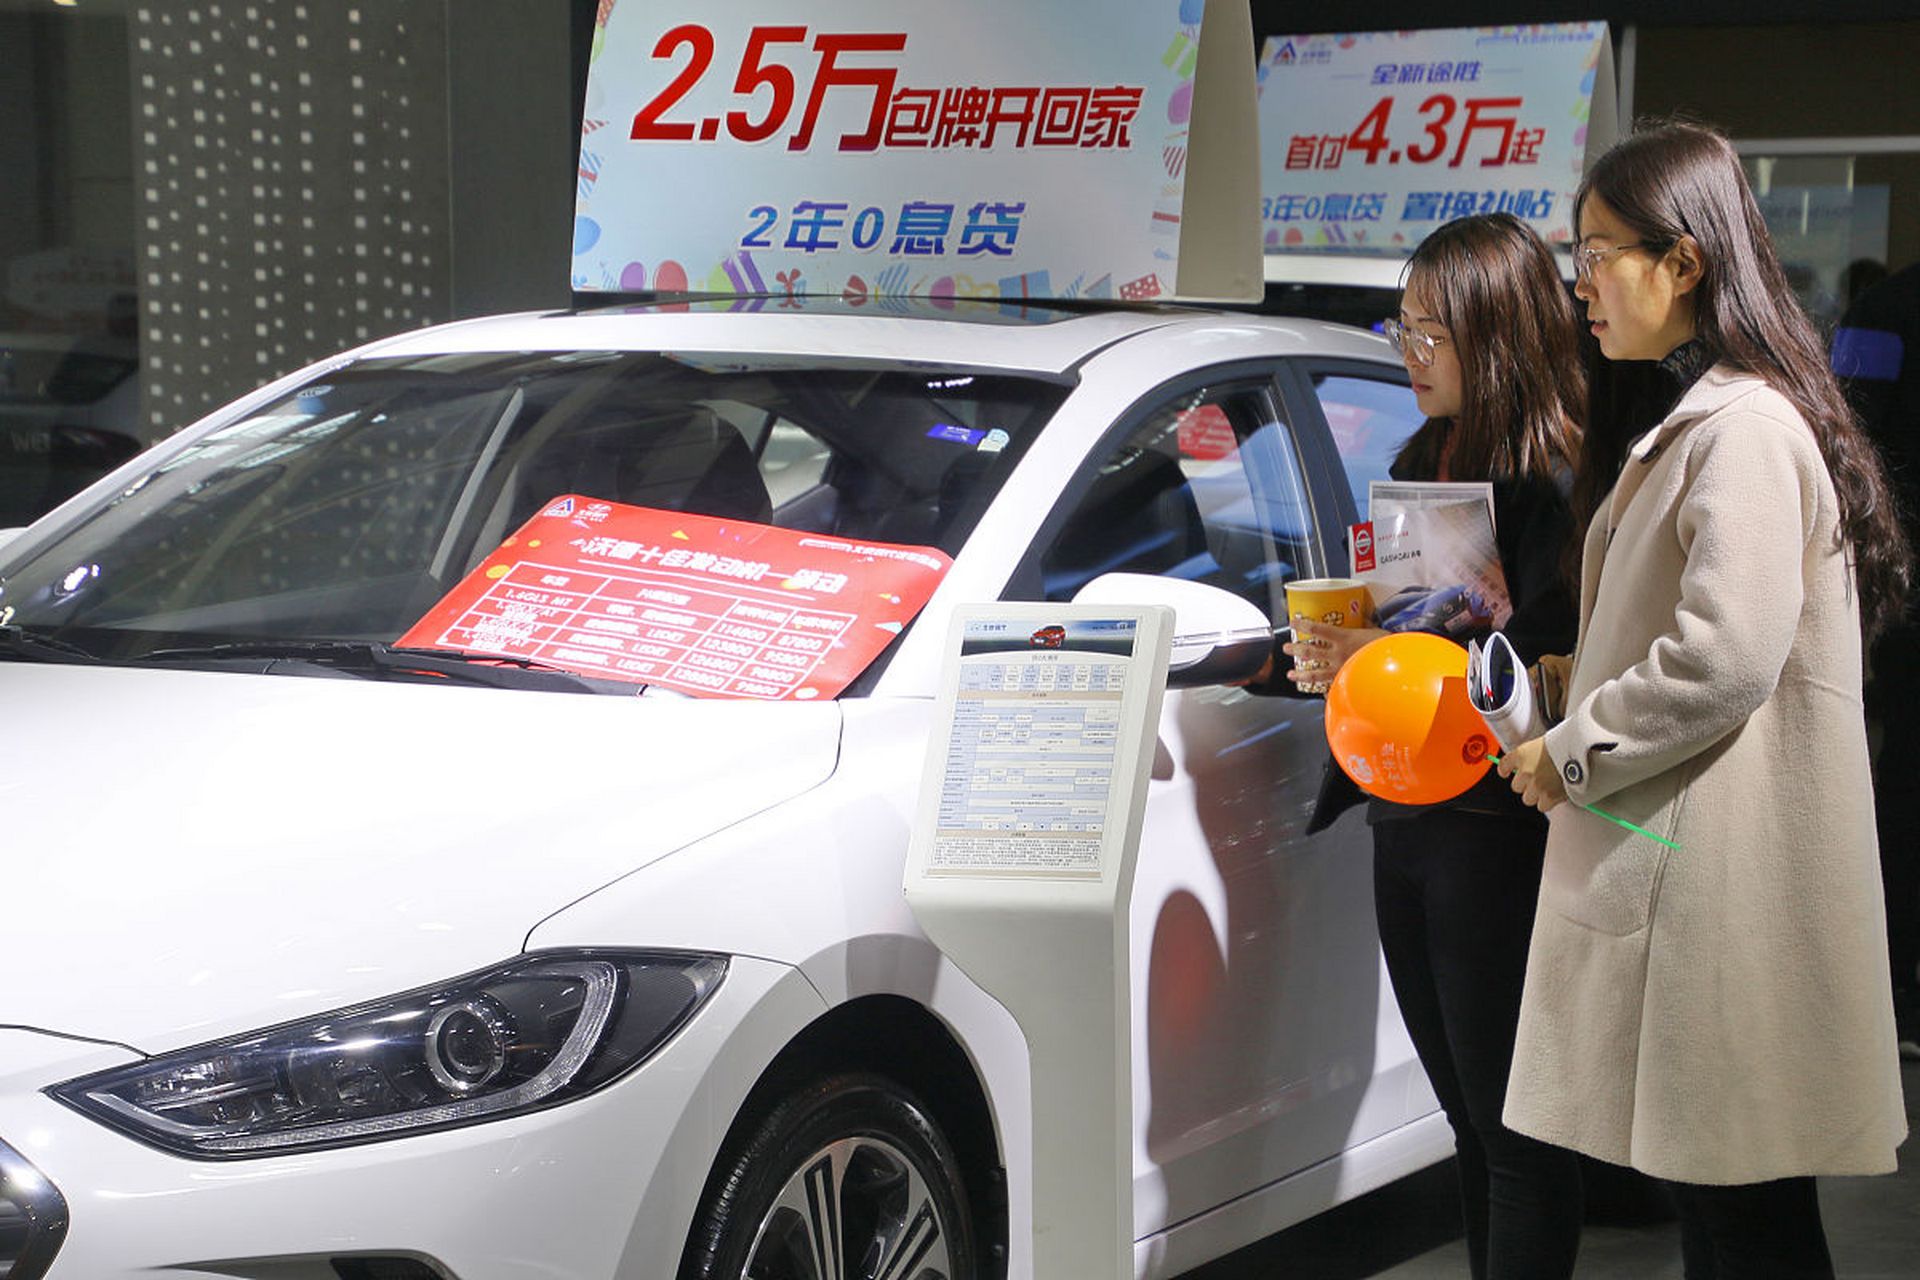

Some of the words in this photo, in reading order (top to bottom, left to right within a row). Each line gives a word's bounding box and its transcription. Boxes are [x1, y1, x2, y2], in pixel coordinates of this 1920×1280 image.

[629, 24, 1144, 152] 2.5万包牌开回家
[1370, 61, 1483, 86] 全新途胜
[1285, 94, 1545, 171] 首付4.3万起
[741, 201, 1027, 256] 2年0息贷
